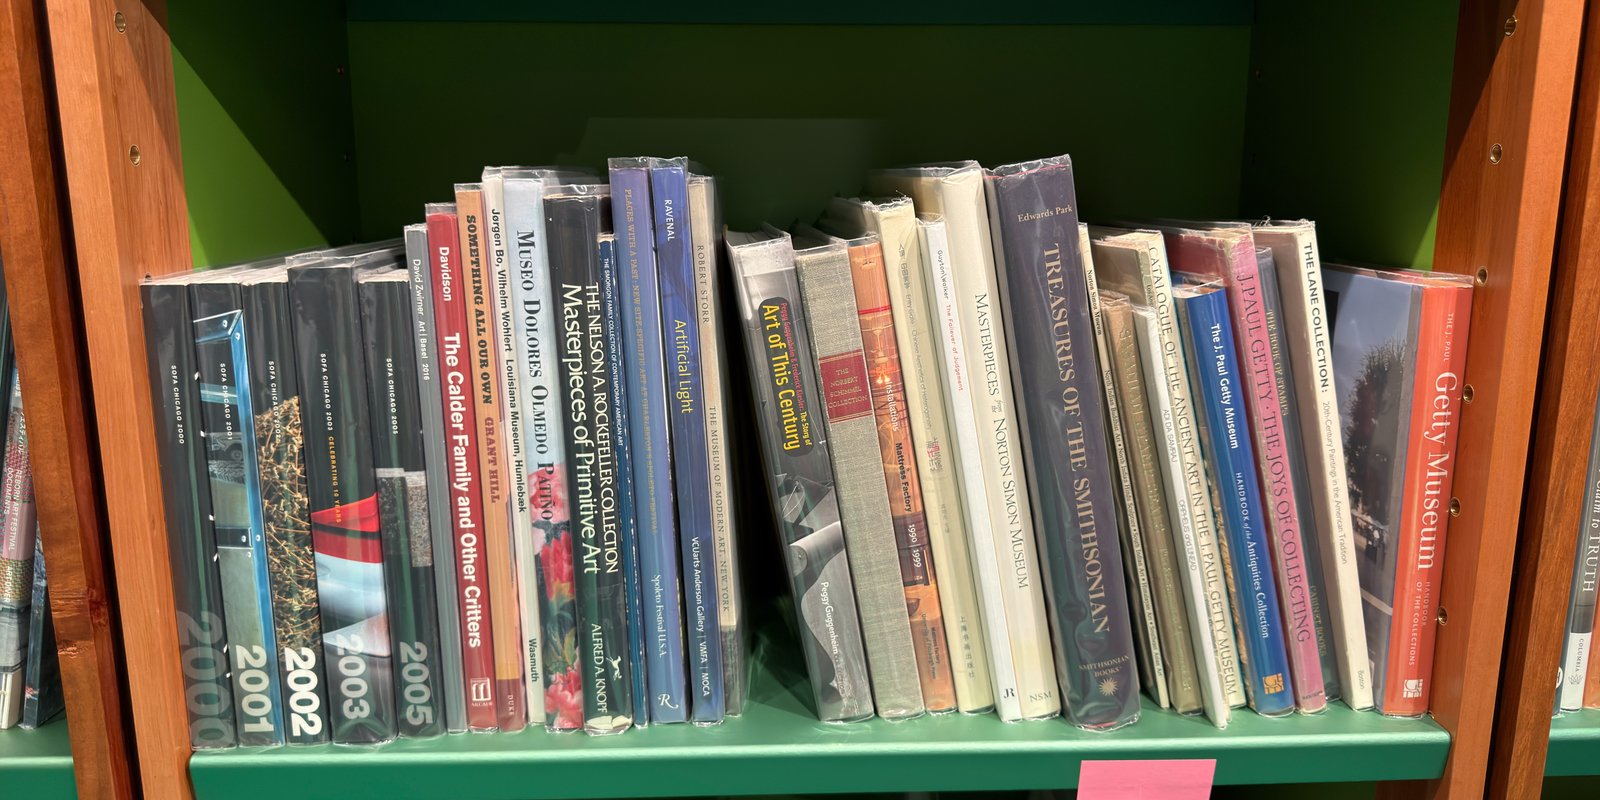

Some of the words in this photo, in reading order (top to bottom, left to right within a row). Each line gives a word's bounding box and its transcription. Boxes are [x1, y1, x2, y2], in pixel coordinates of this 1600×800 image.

[490, 208, 503, 246] Jørgen
[664, 199, 675, 241] RAVENAL
[1017, 209, 1053, 222] Edwards
[1055, 204, 1073, 215] Park
[413, 259, 423, 282] David
[467, 215, 484, 305] SOMETHING
[696, 245, 707, 285] ROBERT
[1304, 242, 1314, 269] THE
[439, 246, 452, 301] Davidson
[498, 269, 509, 308] Vilhelm
[1307, 271, 1318, 304] LANE
[416, 284, 425, 315] Zwirner
[586, 282, 600, 312] THE
[632, 285, 641, 305] NEW
[700, 289, 710, 323] STORR
[1043, 243, 1075, 382] TREASURES
[476, 308, 487, 336] ALL
[502, 311, 513, 352] Wohlert
[762, 304, 781, 330] Art
[1093, 311, 1102, 335] Museum
[1210, 323, 1221, 343] The
[444, 332, 461, 366] The
[478, 339, 489, 369] OUR
[562, 283, 587, 422] Masterpieces
[588, 315, 605, 373] NELSON
[674, 319, 691, 377] Artificial
[768, 333, 785, 349] of
[1312, 307, 1329, 393] COLLECTION:
[1443, 341, 1451, 361] PAUL
[608, 320, 616, 353] COLLECTION
[612, 362, 620, 407] CONTEMPORARY
[771, 352, 791, 386] This
[952, 356, 963, 391] Judgement
[1168, 363, 1180, 390] THE
[1215, 355, 1227, 375] Paul
[1250, 339, 1273, 401] GETTY
[1268, 333, 1280, 361] BOOK
[1276, 377, 1289, 416] STAMPS
[271, 382, 280, 416] CHICAGO
[322, 375, 331, 409] CHICAGO
[388, 379, 397, 413] CHICAGO
[447, 371, 467, 430] Calder
[481, 372, 492, 404] OWN
[506, 359, 516, 408] Louisiana
[676, 381, 694, 413] Light
[1218, 378, 1233, 405] Getty
[173, 387, 182, 420] CHICAGO
[222, 385, 231, 418] CHICAGO
[709, 406, 717, 426] THE
[828, 395, 868, 408] COLLECTION
[886, 381, 901, 431] Installations
[1062, 386, 1080, 417] OF
[1163, 409, 1171, 420] ADI
[1423, 371, 1458, 446] Getty
[511, 411, 521, 457] Museum,
[573, 425, 595, 447] of
[778, 389, 801, 451] Century
[800, 422, 809, 437] Story
[1174, 397, 1196, 456] ANCIENT
[1225, 407, 1239, 449] Museum
[1262, 411, 1279, 451] THE
[485, 416, 498, 466] GRANT
[593, 392, 613, 487] ROCKEFELLER
[710, 429, 720, 471] MUSEUM
[975, 293, 1000, 395] MASTERPIECES
[993, 418, 1012, 477] NORTON
[1003, 480, 1017, 524] SIMON
[1010, 528, 1029, 588] MUSEUM
[1066, 421, 1088, 472] THE
[1166, 434, 1177, 462] SAMRAJ
[452, 434, 473, 491] Family
[895, 442, 908, 480] Mattress
[1185, 461, 1200, 487] ART
[1265, 454, 1288, 496] JOYS
[4, 467, 14, 515] DOCUMENTS
[12, 469, 23, 500] REBORN
[488, 469, 500, 503] HILL
[515, 459, 527, 512] Humlebæk
[576, 452, 597, 538] Primitive
[901, 482, 913, 512] Factory
[1190, 491, 1203, 507] IN
[1236, 472, 1249, 521] HANDBOOK
[458, 496, 476, 528] and
[715, 490, 725, 532] MODERN
[1178, 499, 1190, 532] ORPHEUS
[1184, 533, 1192, 546] and
[1194, 509, 1208, 538] THE
[1277, 500, 1293, 525] OF
[1417, 452, 1450, 570] Museum
[1591, 518, 1600, 528] to
[8, 517, 18, 551] FESTIVAL
[601, 487, 618, 573] COLLECTION
[907, 524, 918, 543] 1990
[461, 533, 479, 582] Other
[582, 542, 601, 573] Art
[911, 549, 922, 567] 1999
[1072, 477, 1110, 634] SMITHSONIAN
[1202, 553, 1216, 587] PAUL
[1246, 540, 1262, 590] Antiquities
[1582, 534, 1600, 592] TRUTH
[651, 574, 663, 603] Spoleto
[693, 569, 703, 604] Anderson
[820, 582, 831, 605] Peggy
[1281, 528, 1310, 643] COLLECTING
[1414, 595, 1422, 610] THE
[464, 585, 482, 648] Critters
[655, 605, 666, 632] Festival
[695, 606, 705, 632] Gallery
[1208, 591, 1227, 633] GETTY
[1256, 592, 1270, 638] Collection
[1422, 581, 1431, 627] HANDBOOK
[591, 623, 604, 664] ALFRED
[825, 605, 840, 654] Guggenheim
[1408, 612, 1420, 666] COLLECTIONS
[529, 638, 539, 682] Wasmuth
[1079, 655, 1129, 670] SMITHSONIAN
[1218, 638, 1237, 695] MUSEUM
[1575, 638, 1584, 671] COLUMBIA
[176, 610, 235, 742] 2000
[235, 645, 274, 732] 2001
[284, 647, 322, 736] 2002
[336, 633, 370, 719] 2003
[400, 641, 433, 726] 2005
[701, 672, 710, 696] MOCA
[596, 678, 607, 713] KNOPF
[658, 694, 679, 709] R
[1029, 690, 1052, 702] NSM
